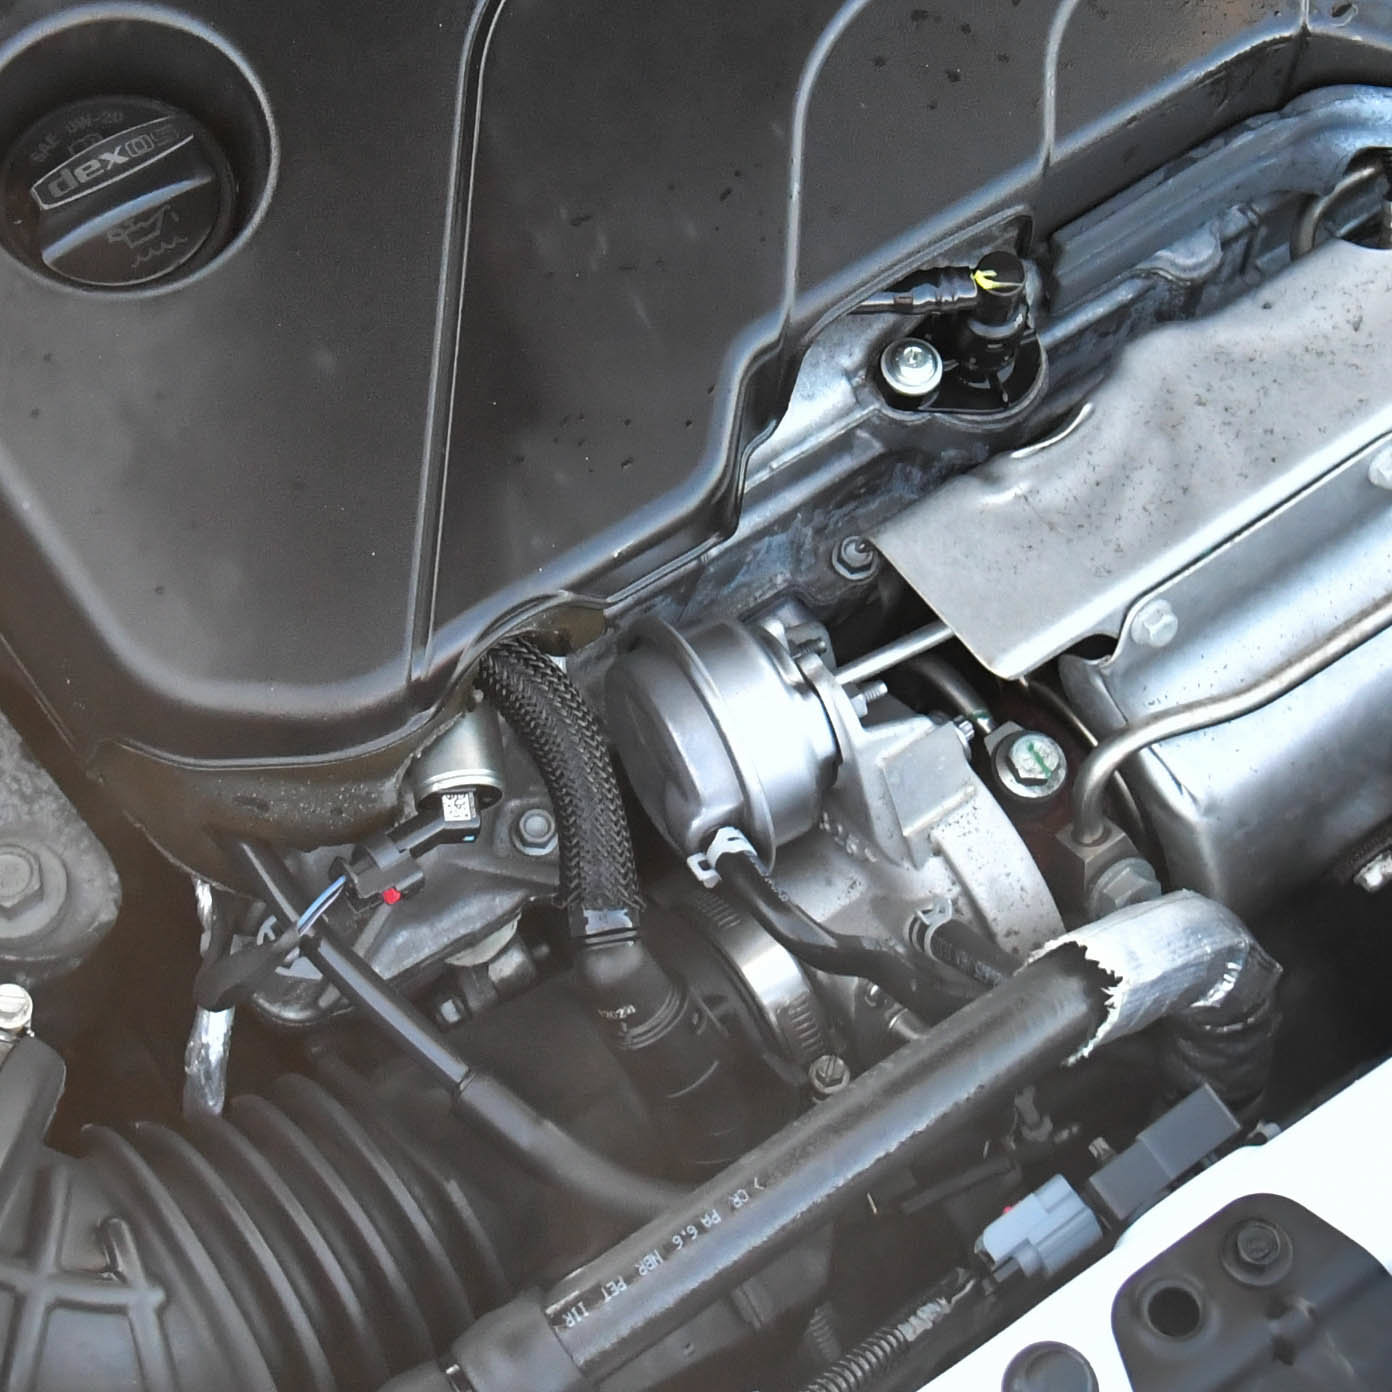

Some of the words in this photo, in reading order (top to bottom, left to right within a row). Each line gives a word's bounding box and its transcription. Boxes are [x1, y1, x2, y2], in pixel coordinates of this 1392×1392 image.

[48, 123, 176, 198] dexos
[728, 1188, 750, 1209] CR
[701, 1209, 722, 1228] PA
[672, 1224, 699, 1250] 6.6
[601, 1276, 628, 1303] PET
